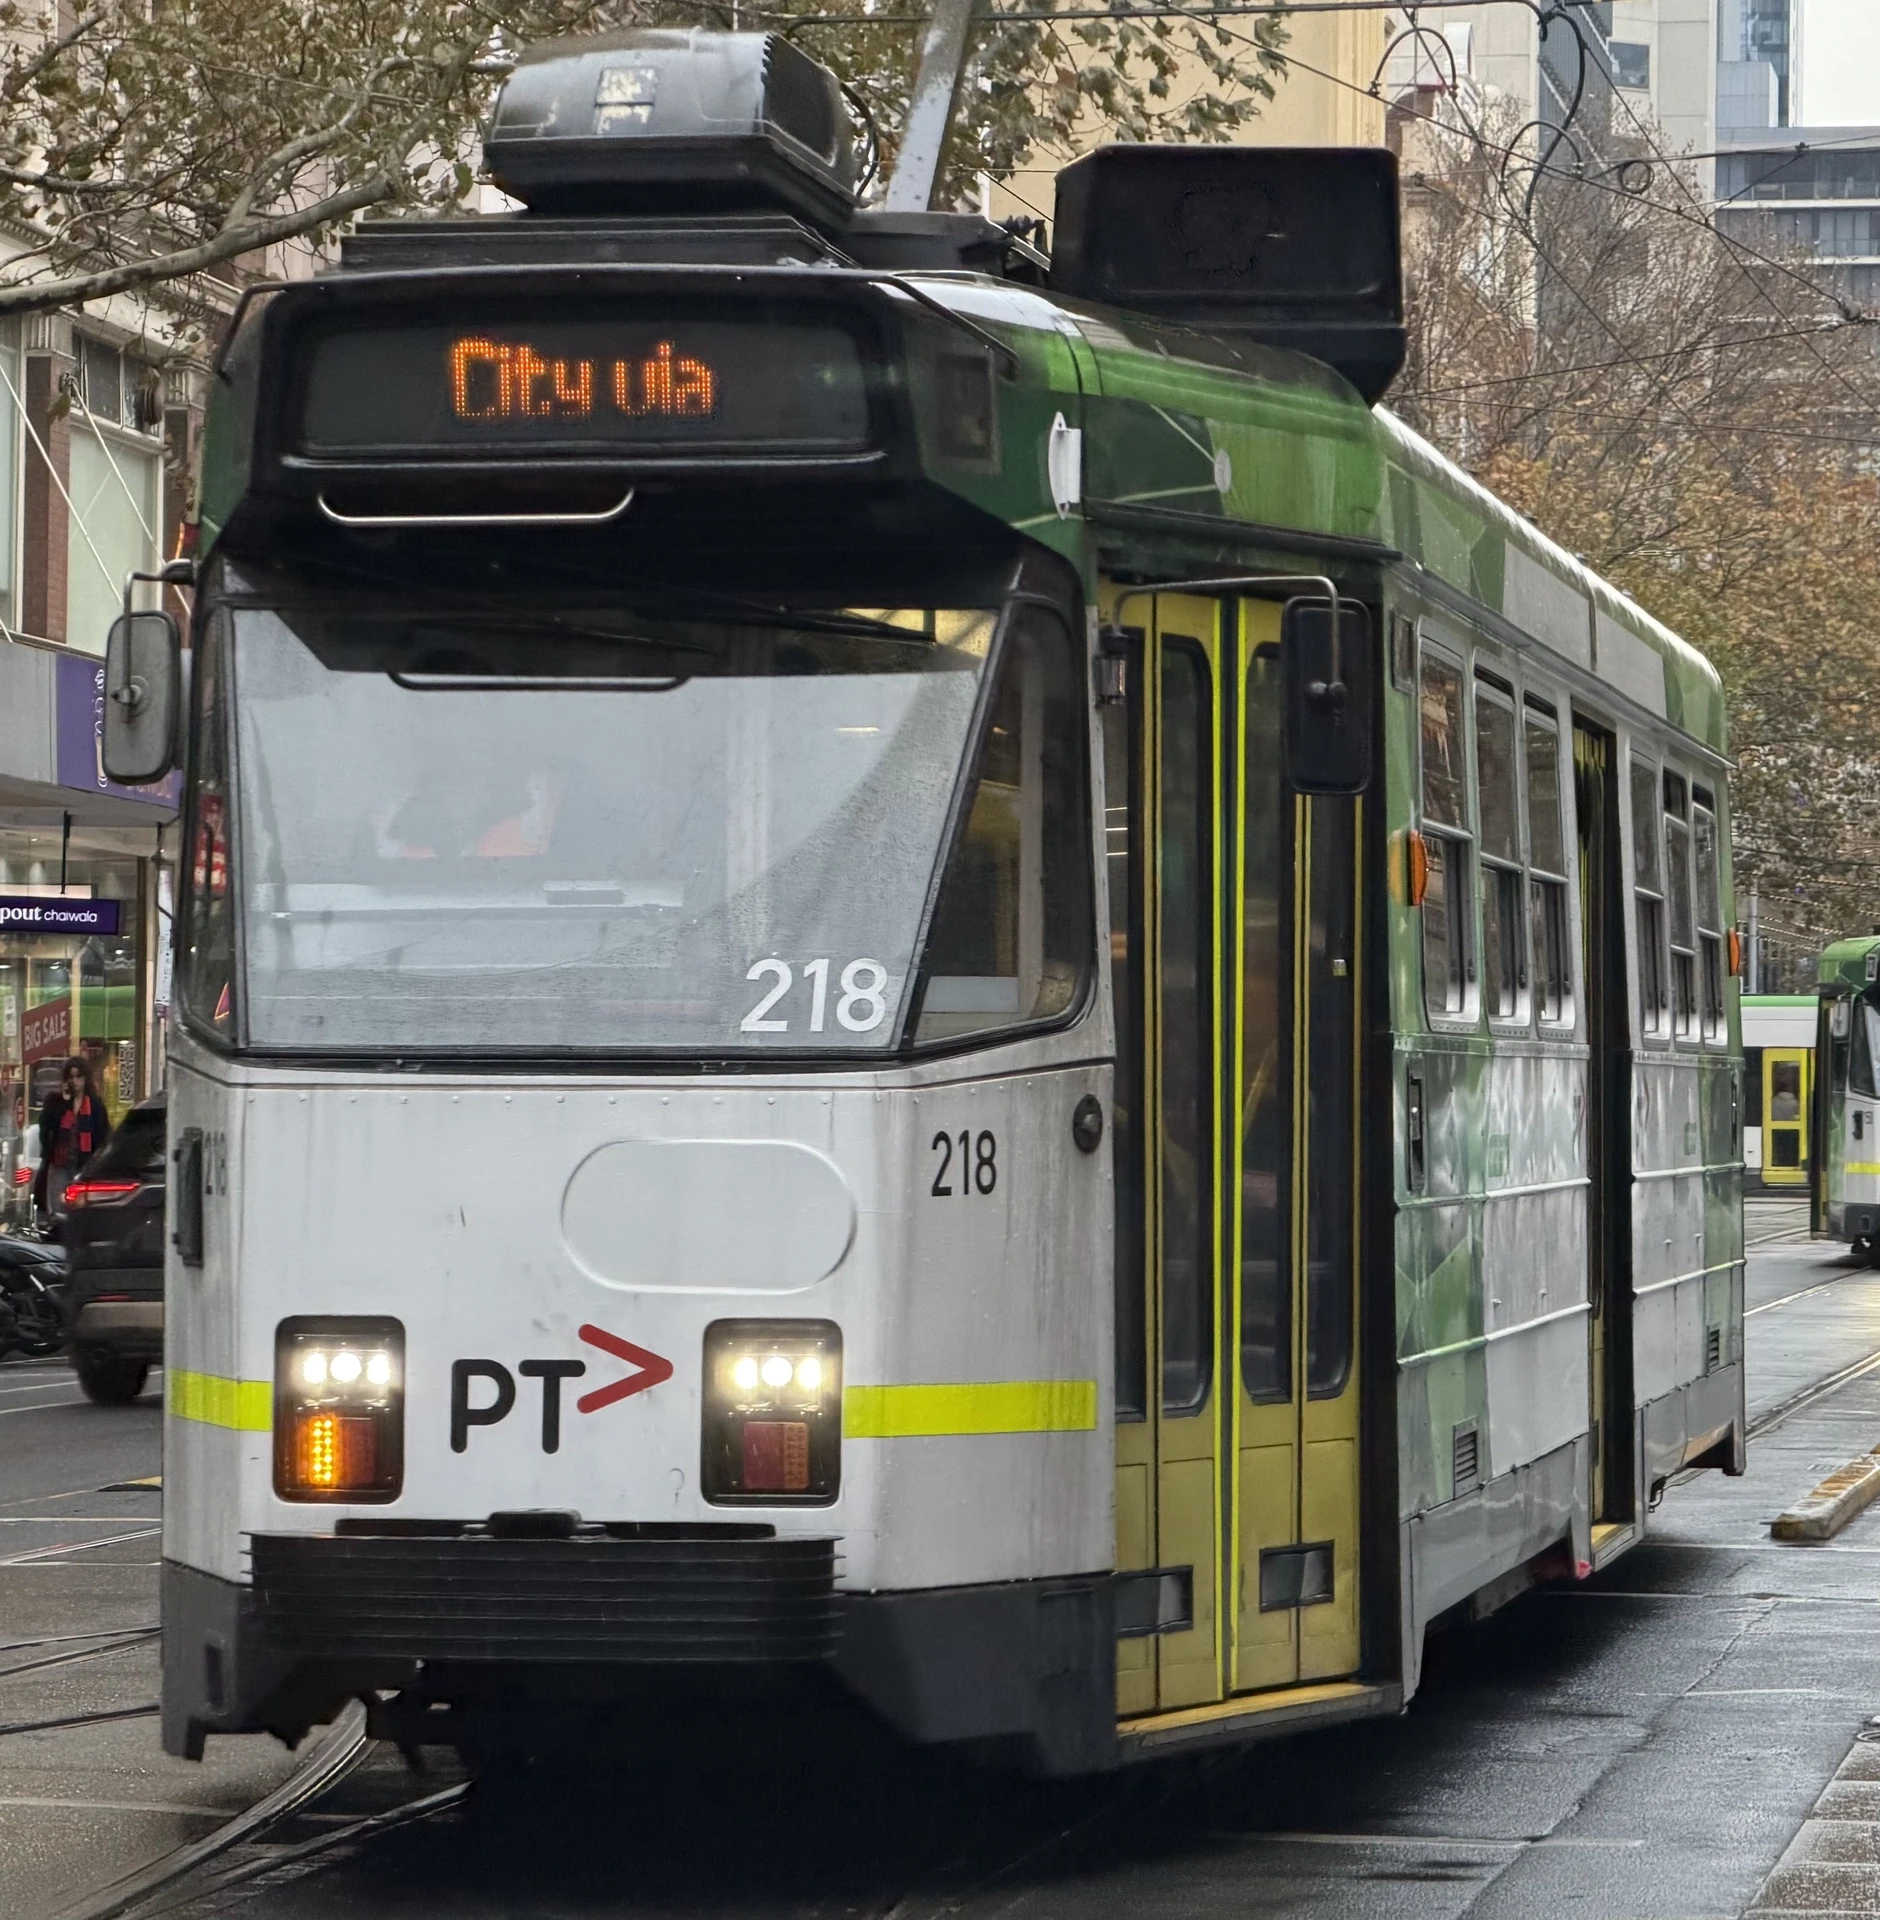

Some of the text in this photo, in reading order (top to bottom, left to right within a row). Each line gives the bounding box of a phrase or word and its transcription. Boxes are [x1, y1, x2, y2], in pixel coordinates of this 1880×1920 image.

[453, 338, 594, 418] City
[44, 909, 98, 922] chaiwala
[740, 957, 888, 1032] 218
[24, 1021, 41, 1052] BIG
[43, 1010, 67, 1044] SALE
[931, 1129, 997, 1196] 218
[450, 1359, 586, 1455] PT
